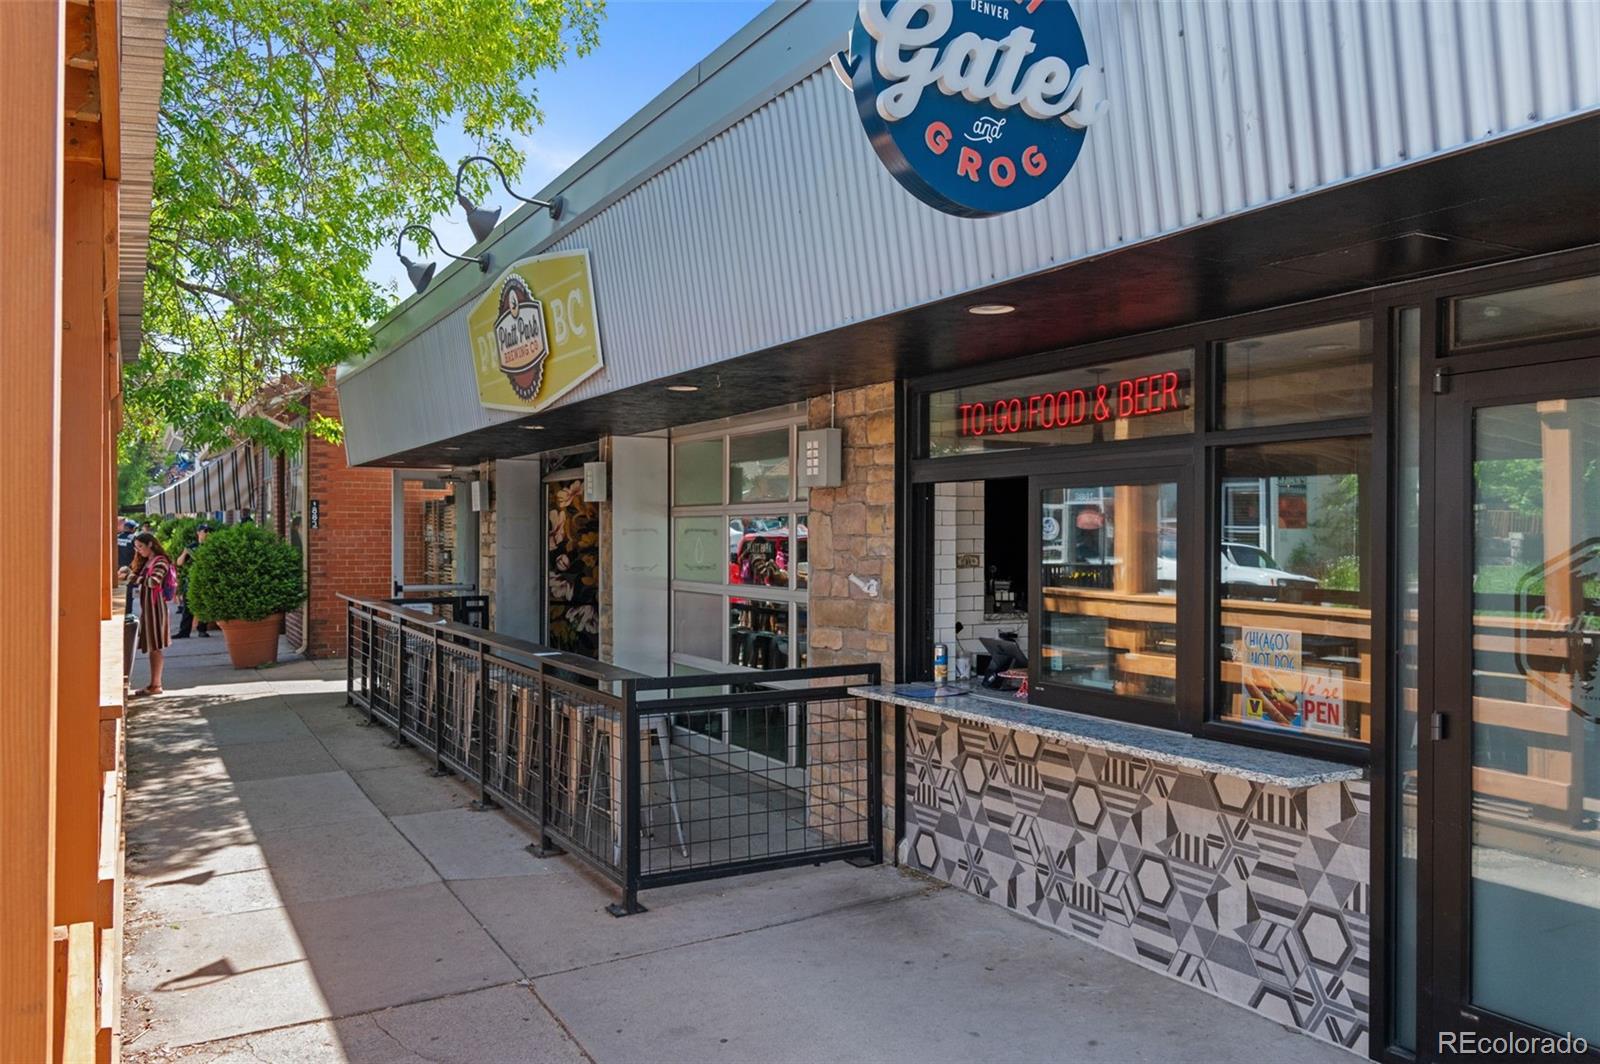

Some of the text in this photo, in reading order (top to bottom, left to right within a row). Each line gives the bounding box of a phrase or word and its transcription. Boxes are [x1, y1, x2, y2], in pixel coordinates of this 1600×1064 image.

[970, 0, 1009, 20] DENVER
[858, 0, 1111, 129] Gates
[925, 121, 1048, 187] GROG
[964, 116, 1006, 143] and
[499, 314, 539, 351] Platt Park
[959, 371, 1179, 436] TO-GO FOOD & BEER
